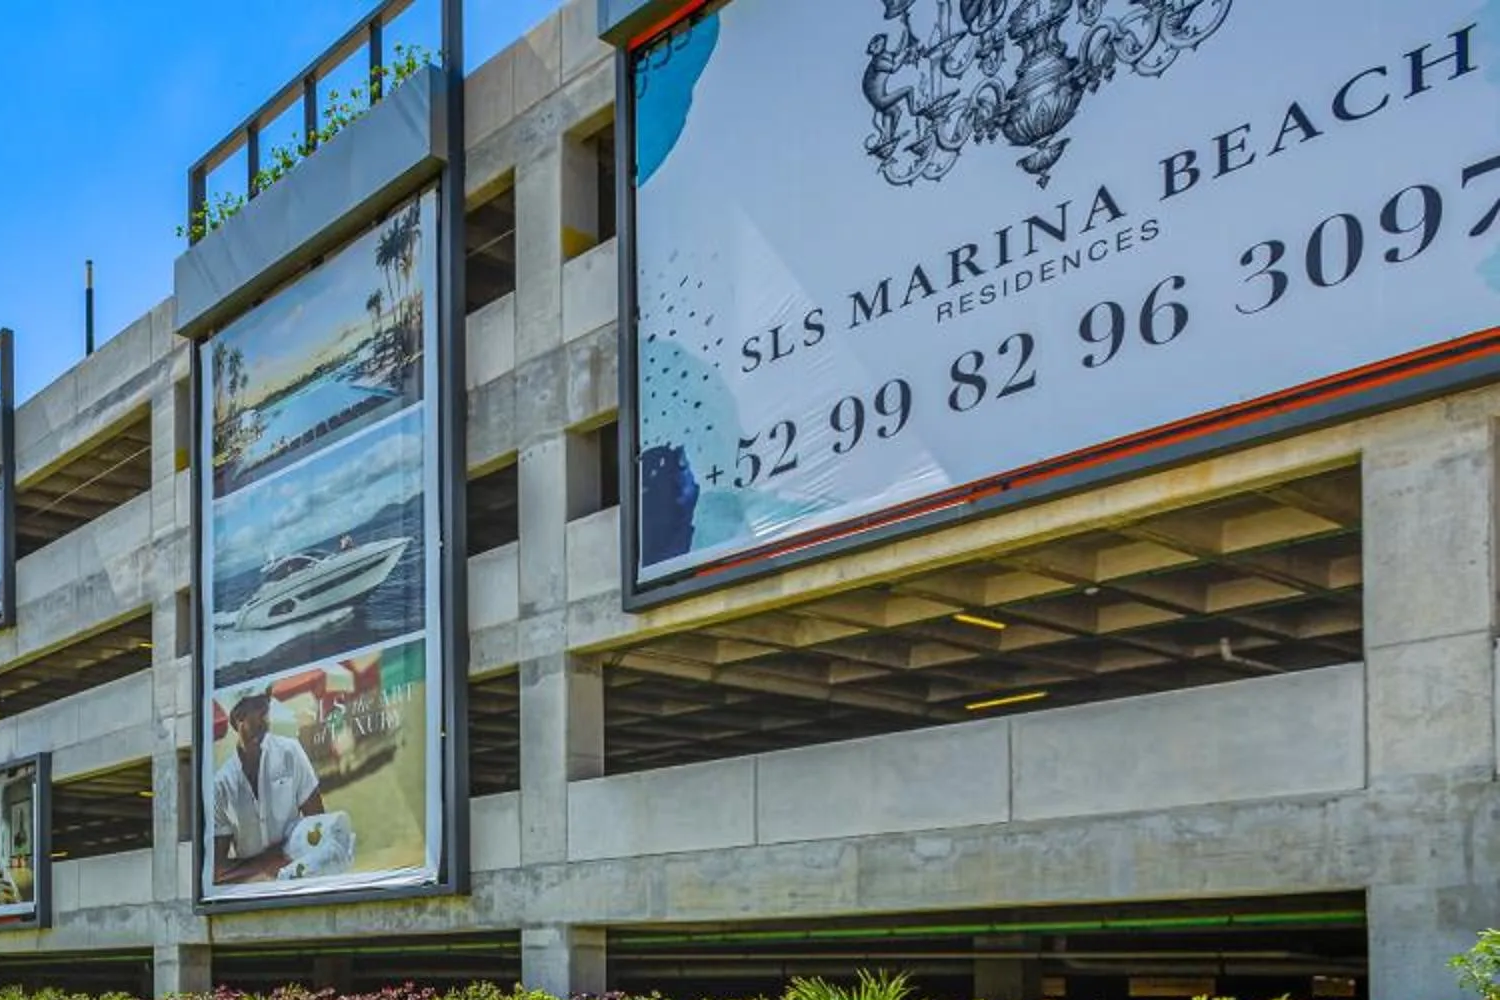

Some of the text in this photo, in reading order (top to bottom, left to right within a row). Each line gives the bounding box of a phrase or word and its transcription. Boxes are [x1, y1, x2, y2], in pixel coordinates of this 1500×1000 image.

[704, 155, 1500, 489] +52 99 82 96 3097
[740, 22, 1479, 374] SLS MARINA BEACH
[936, 219, 1160, 324] RESIDENCES
